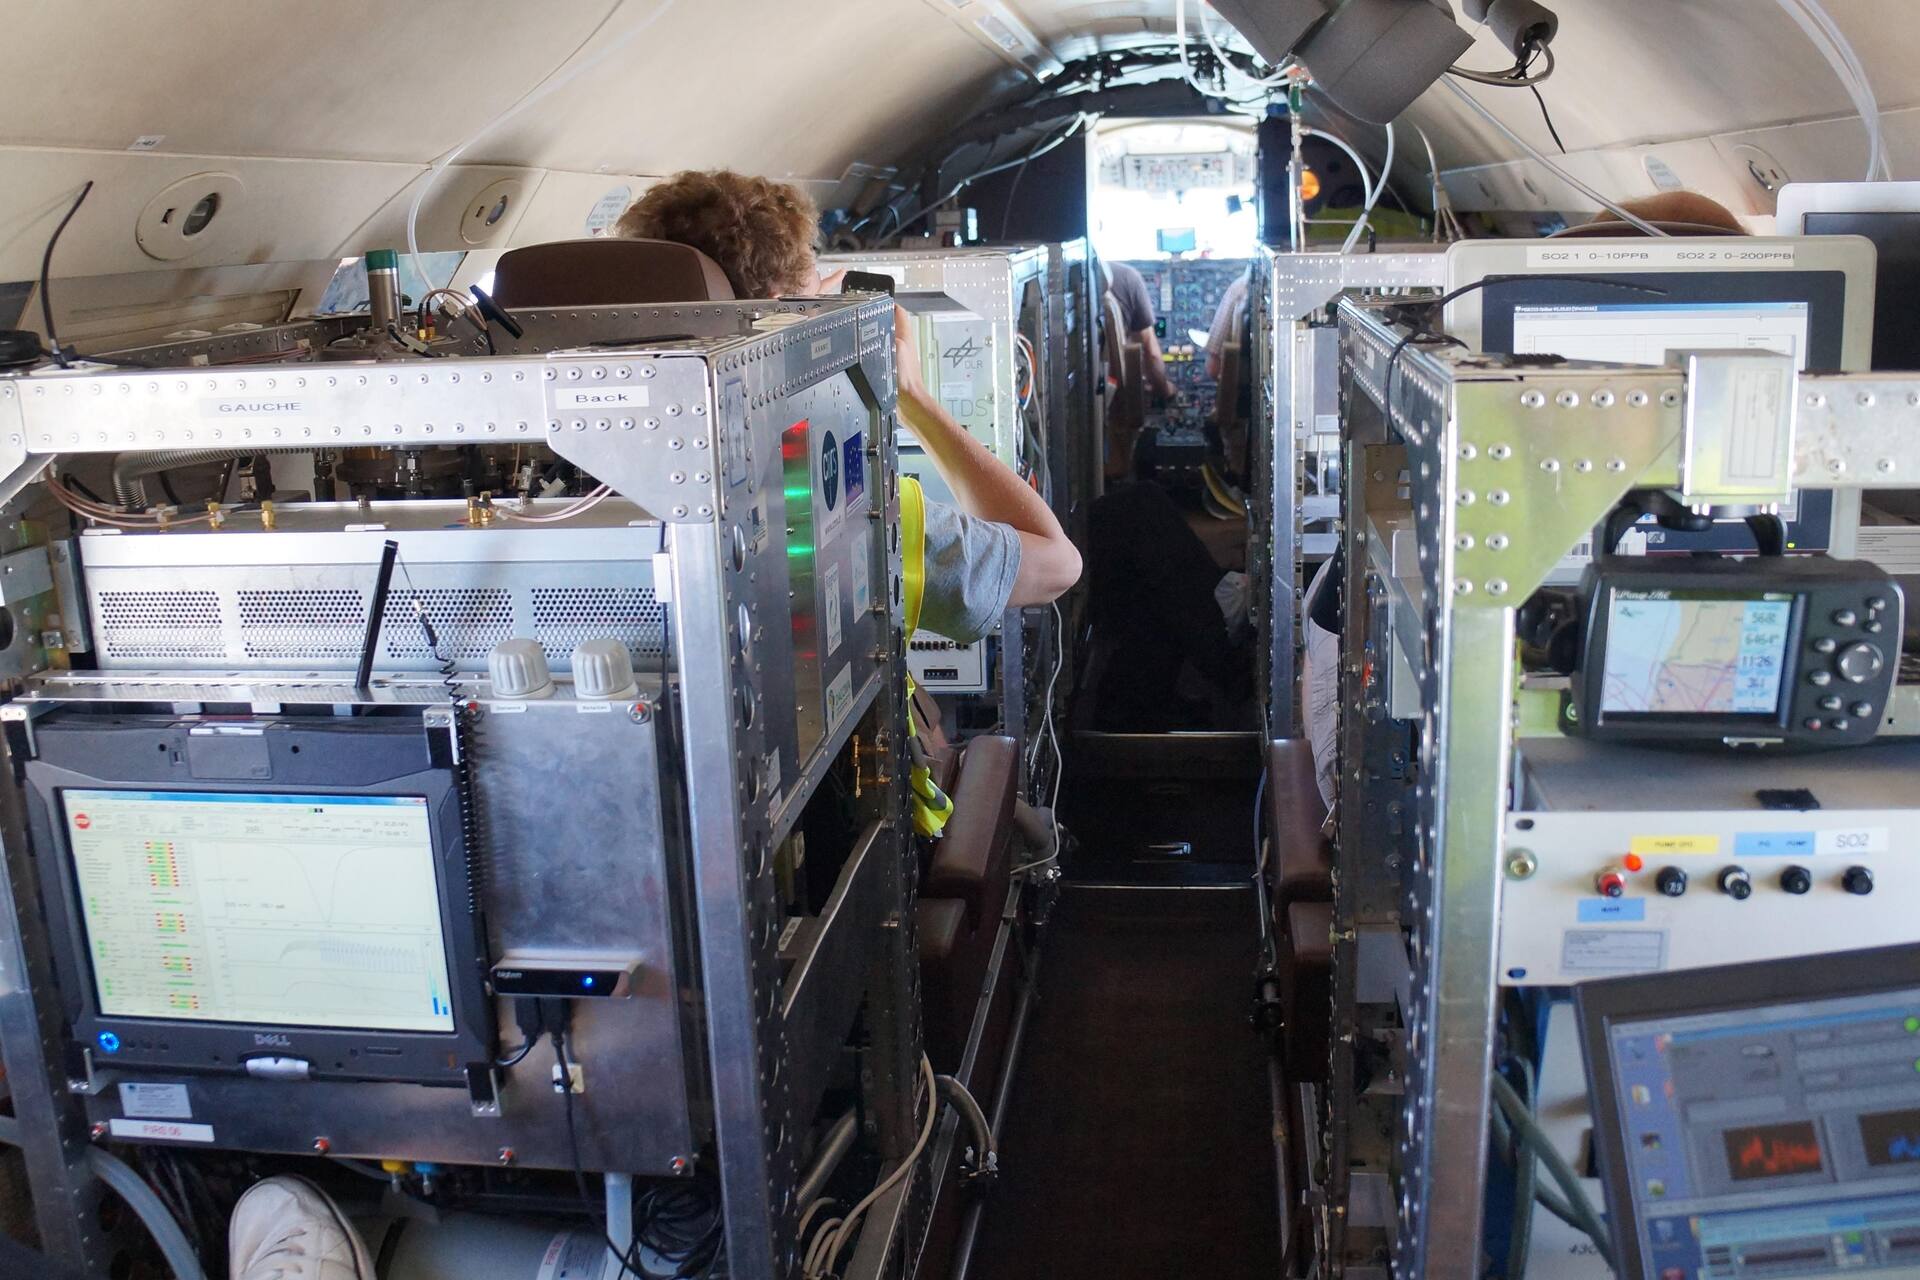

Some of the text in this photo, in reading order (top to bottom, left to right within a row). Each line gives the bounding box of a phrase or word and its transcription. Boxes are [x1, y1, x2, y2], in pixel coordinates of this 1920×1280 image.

[575, 393, 628, 403] Back
[219, 402, 302, 413] GAUCHE
[946, 398, 988, 417] TDS
[1836, 833, 1869, 848] SO2
[254, 1032, 291, 1046] DELL
